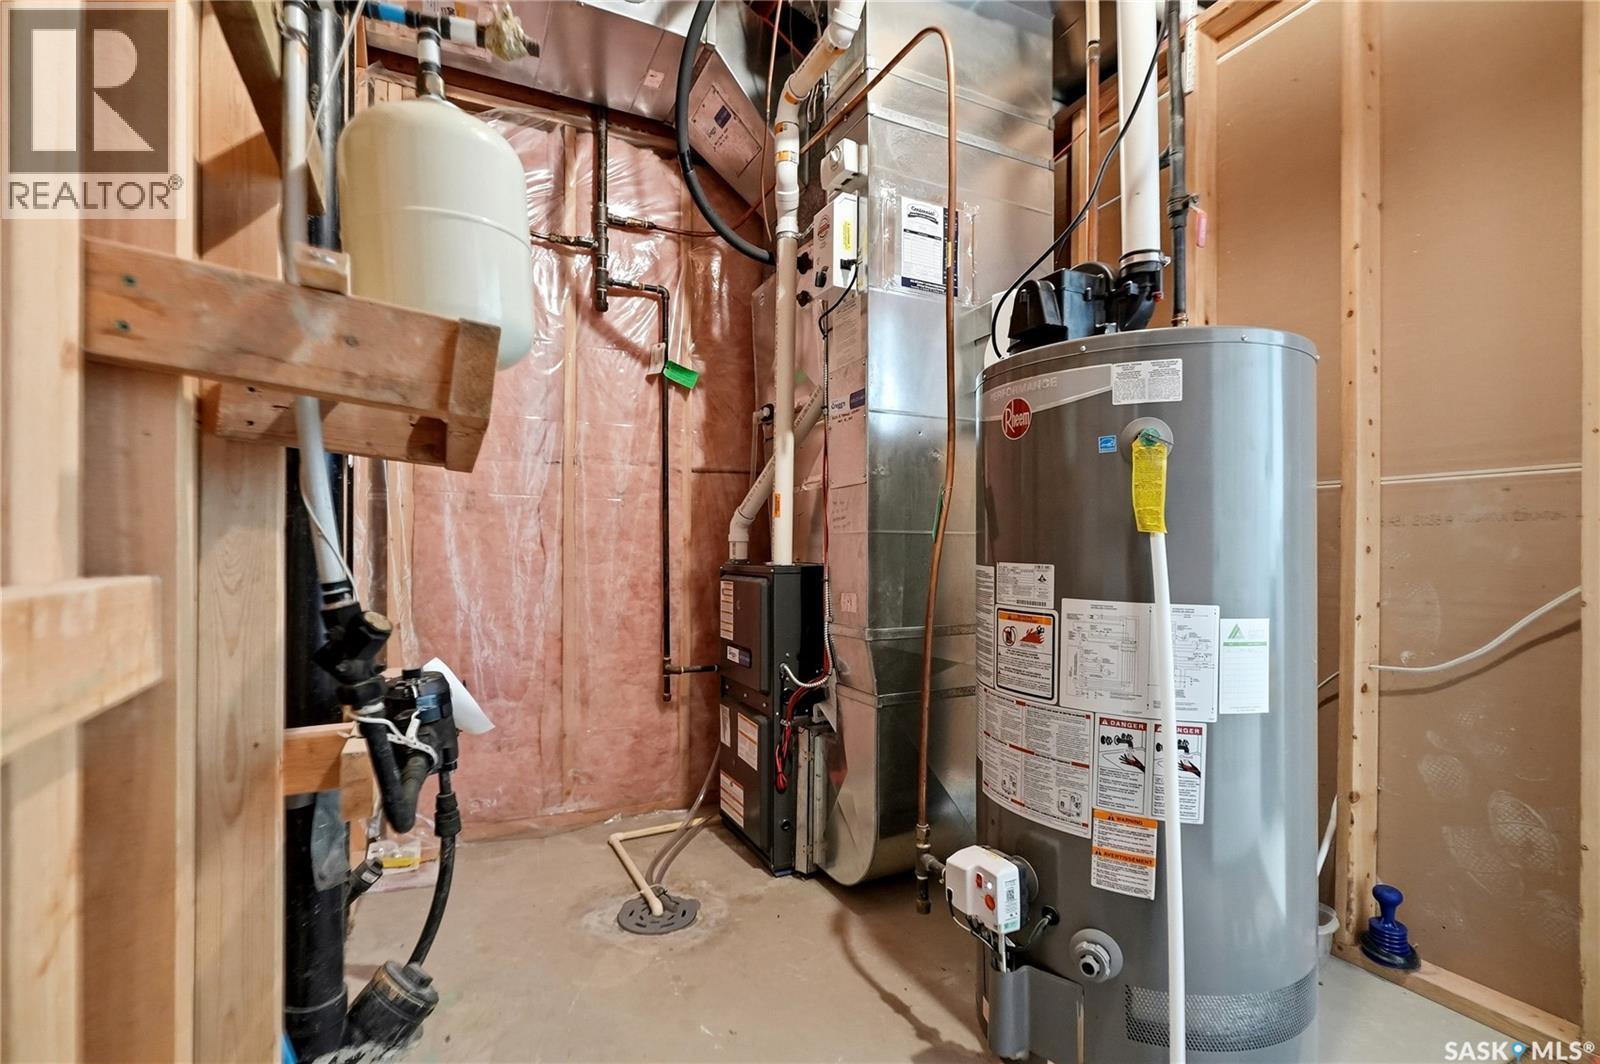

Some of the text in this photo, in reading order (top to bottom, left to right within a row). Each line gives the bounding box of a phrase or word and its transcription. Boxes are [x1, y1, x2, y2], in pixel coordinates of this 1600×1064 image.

[1004, 399, 1030, 433] Rheem
[1110, 720, 1145, 730] DANGER
[1176, 725, 1201, 735] NGER
[1116, 815, 1143, 825] WARNING
